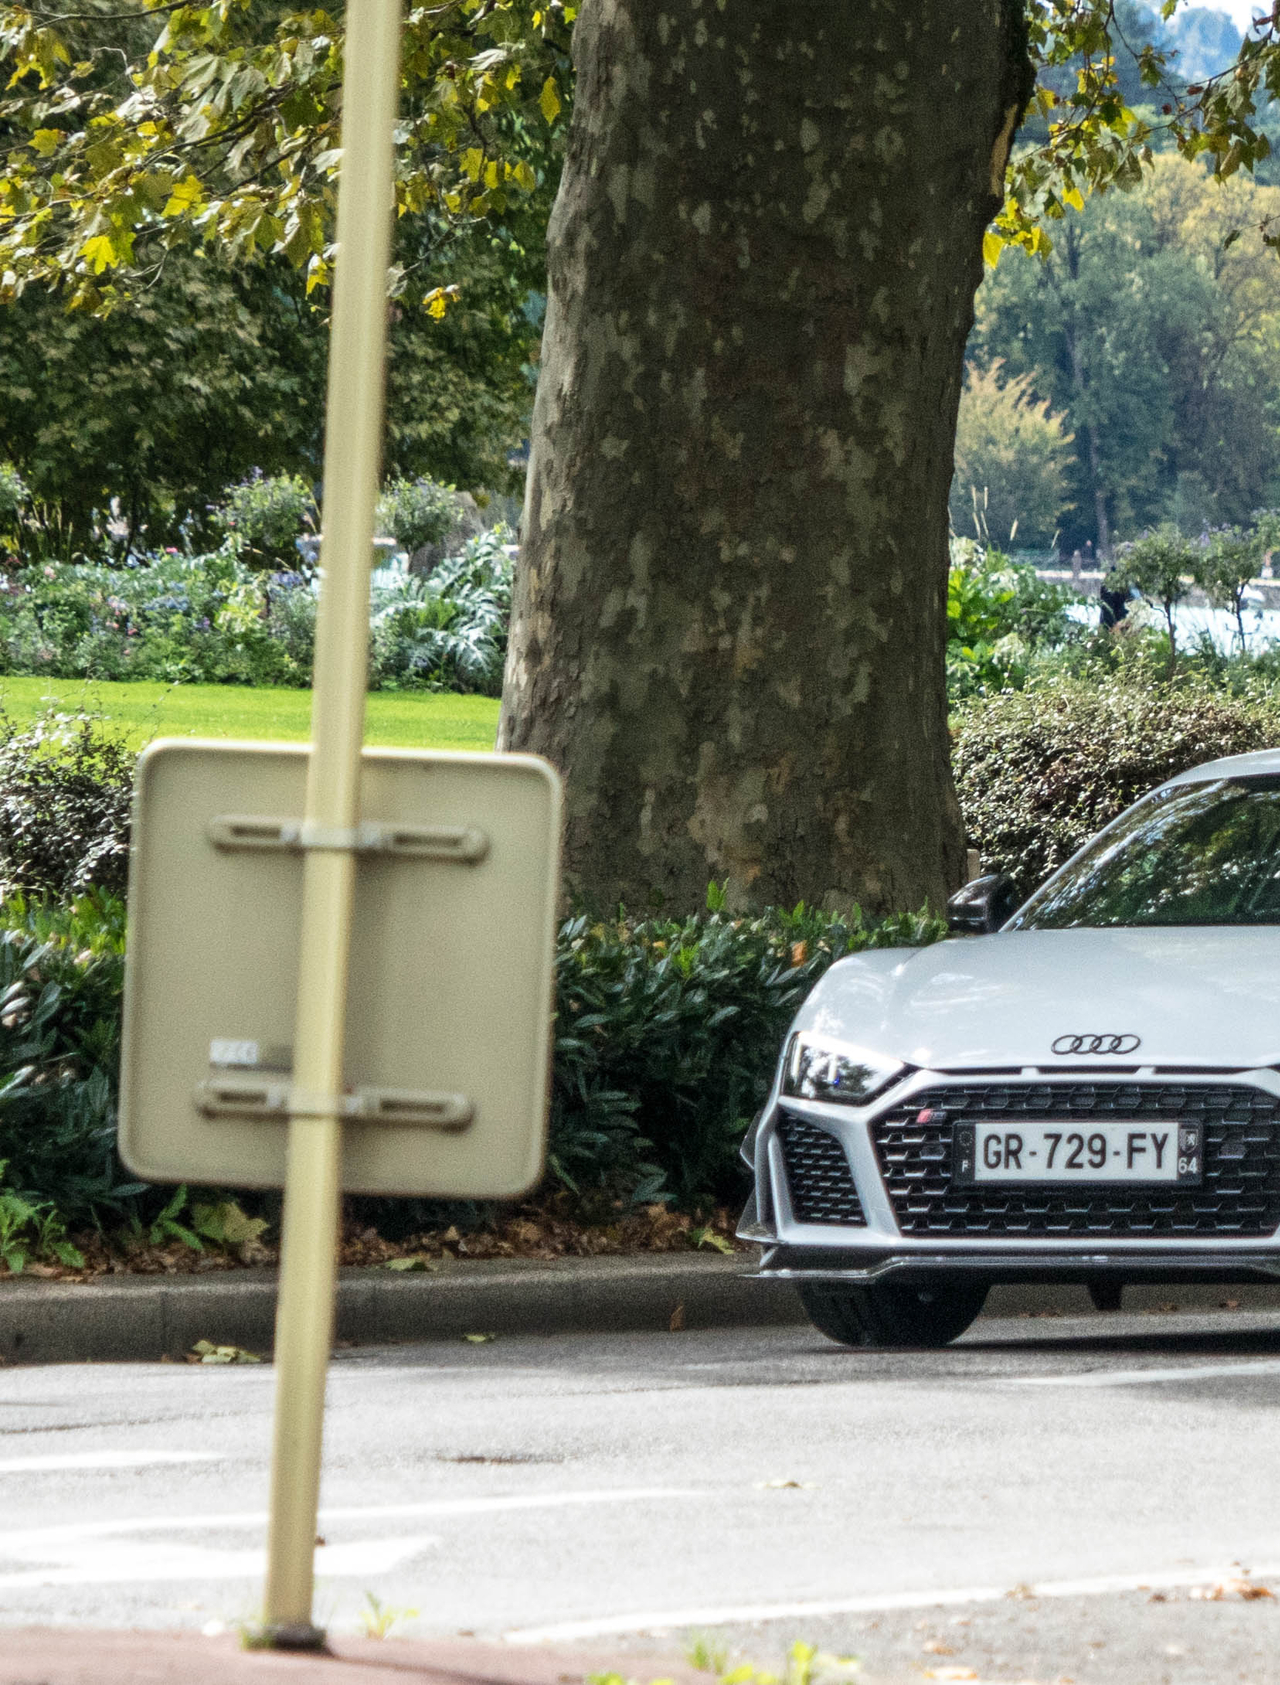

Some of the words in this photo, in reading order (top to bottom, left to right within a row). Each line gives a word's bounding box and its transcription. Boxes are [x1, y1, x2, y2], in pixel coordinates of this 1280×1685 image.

[983, 1132, 1169, 1170] GR-729-FY
[961, 1160, 969, 1173] F
[1178, 1156, 1198, 1174] 64
